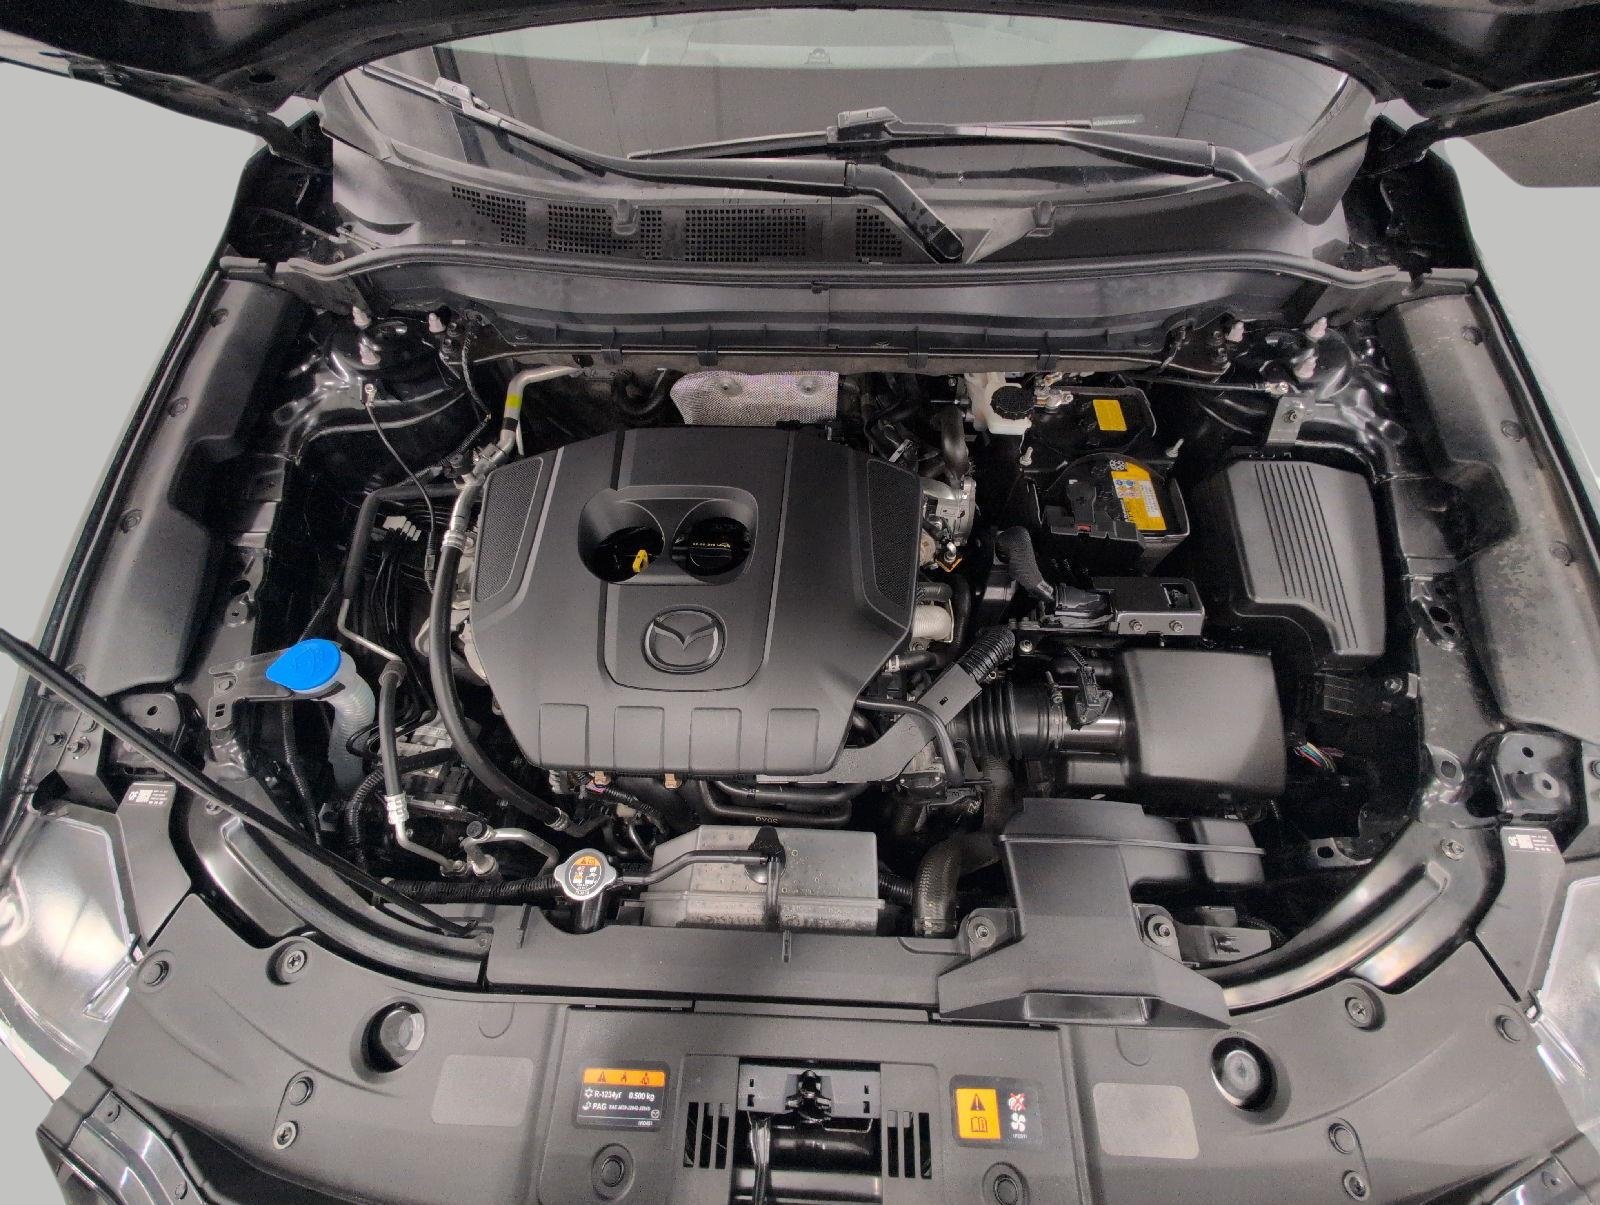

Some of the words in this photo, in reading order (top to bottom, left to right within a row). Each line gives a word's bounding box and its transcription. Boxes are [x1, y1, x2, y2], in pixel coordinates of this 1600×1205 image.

[594, 1090, 622, 1100] R-1234yf
[628, 1092, 645, 1100] 0.500
[646, 1092, 655, 1101] kg
